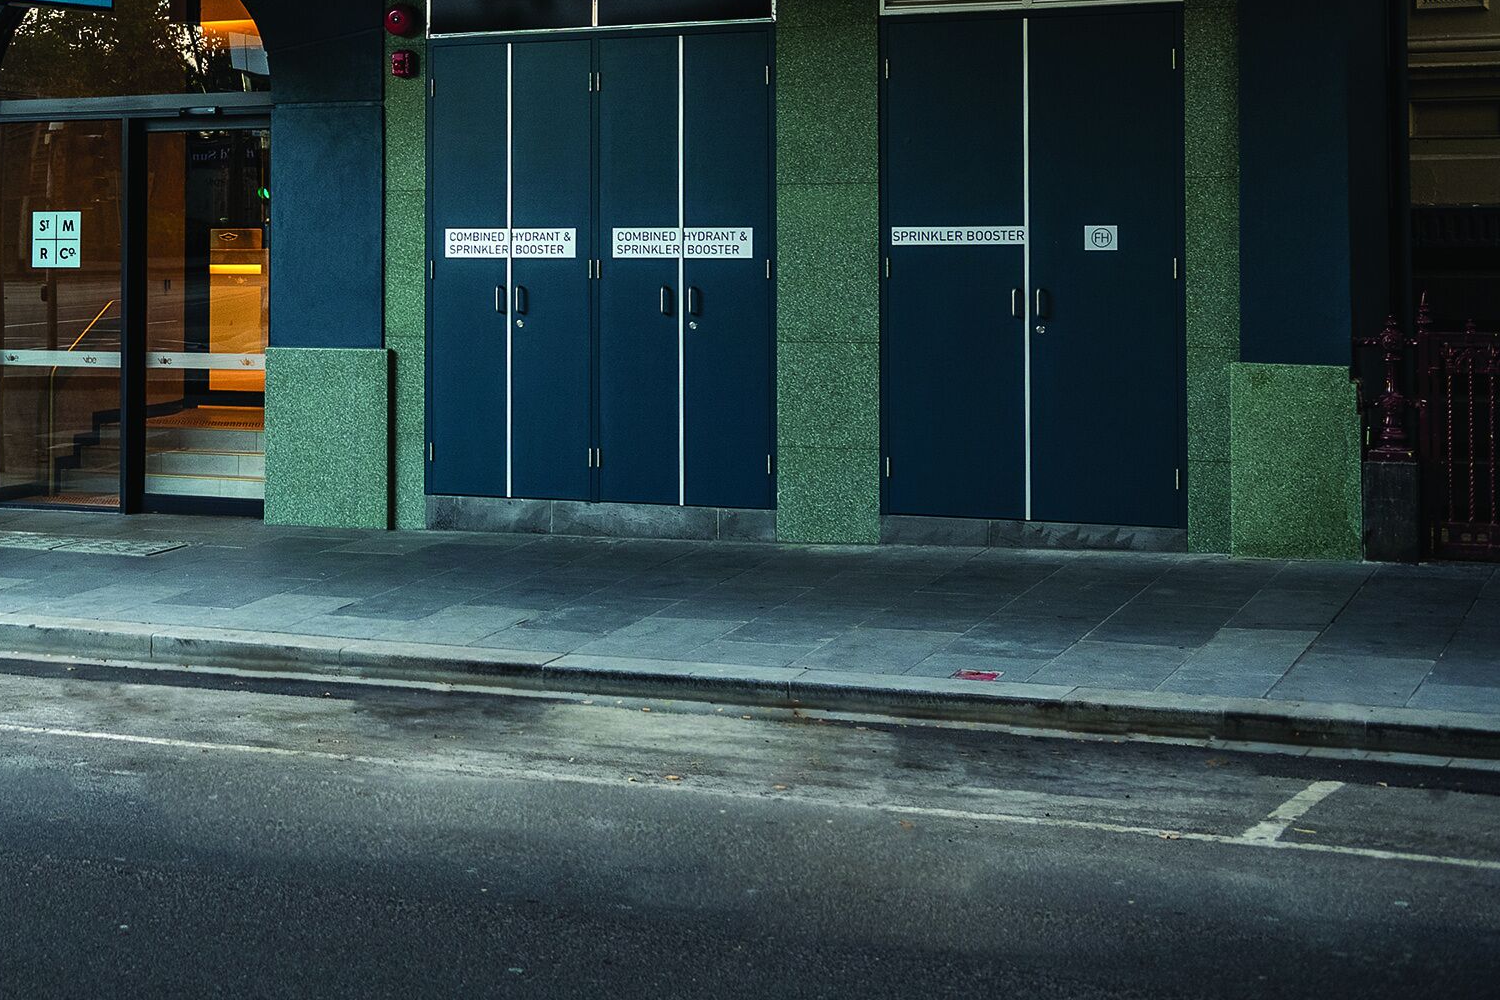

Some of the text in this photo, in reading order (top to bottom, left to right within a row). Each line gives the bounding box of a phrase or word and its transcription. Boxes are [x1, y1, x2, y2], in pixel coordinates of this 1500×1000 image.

[62, 219, 75, 232] M
[449, 231, 571, 242] COMBINED HYDRANT &
[617, 231, 748, 242] COMBINED HYDRANT &
[892, 230, 1025, 242] SPRINKLER BOOSTER
[1094, 232, 1110, 243] FH
[40, 247, 48, 260] R
[449, 244, 564, 255] SPRINKLER BOOSTER
[616, 244, 740, 255] SPRINKLER BOOSTER
[82, 355, 97, 364] vibe
